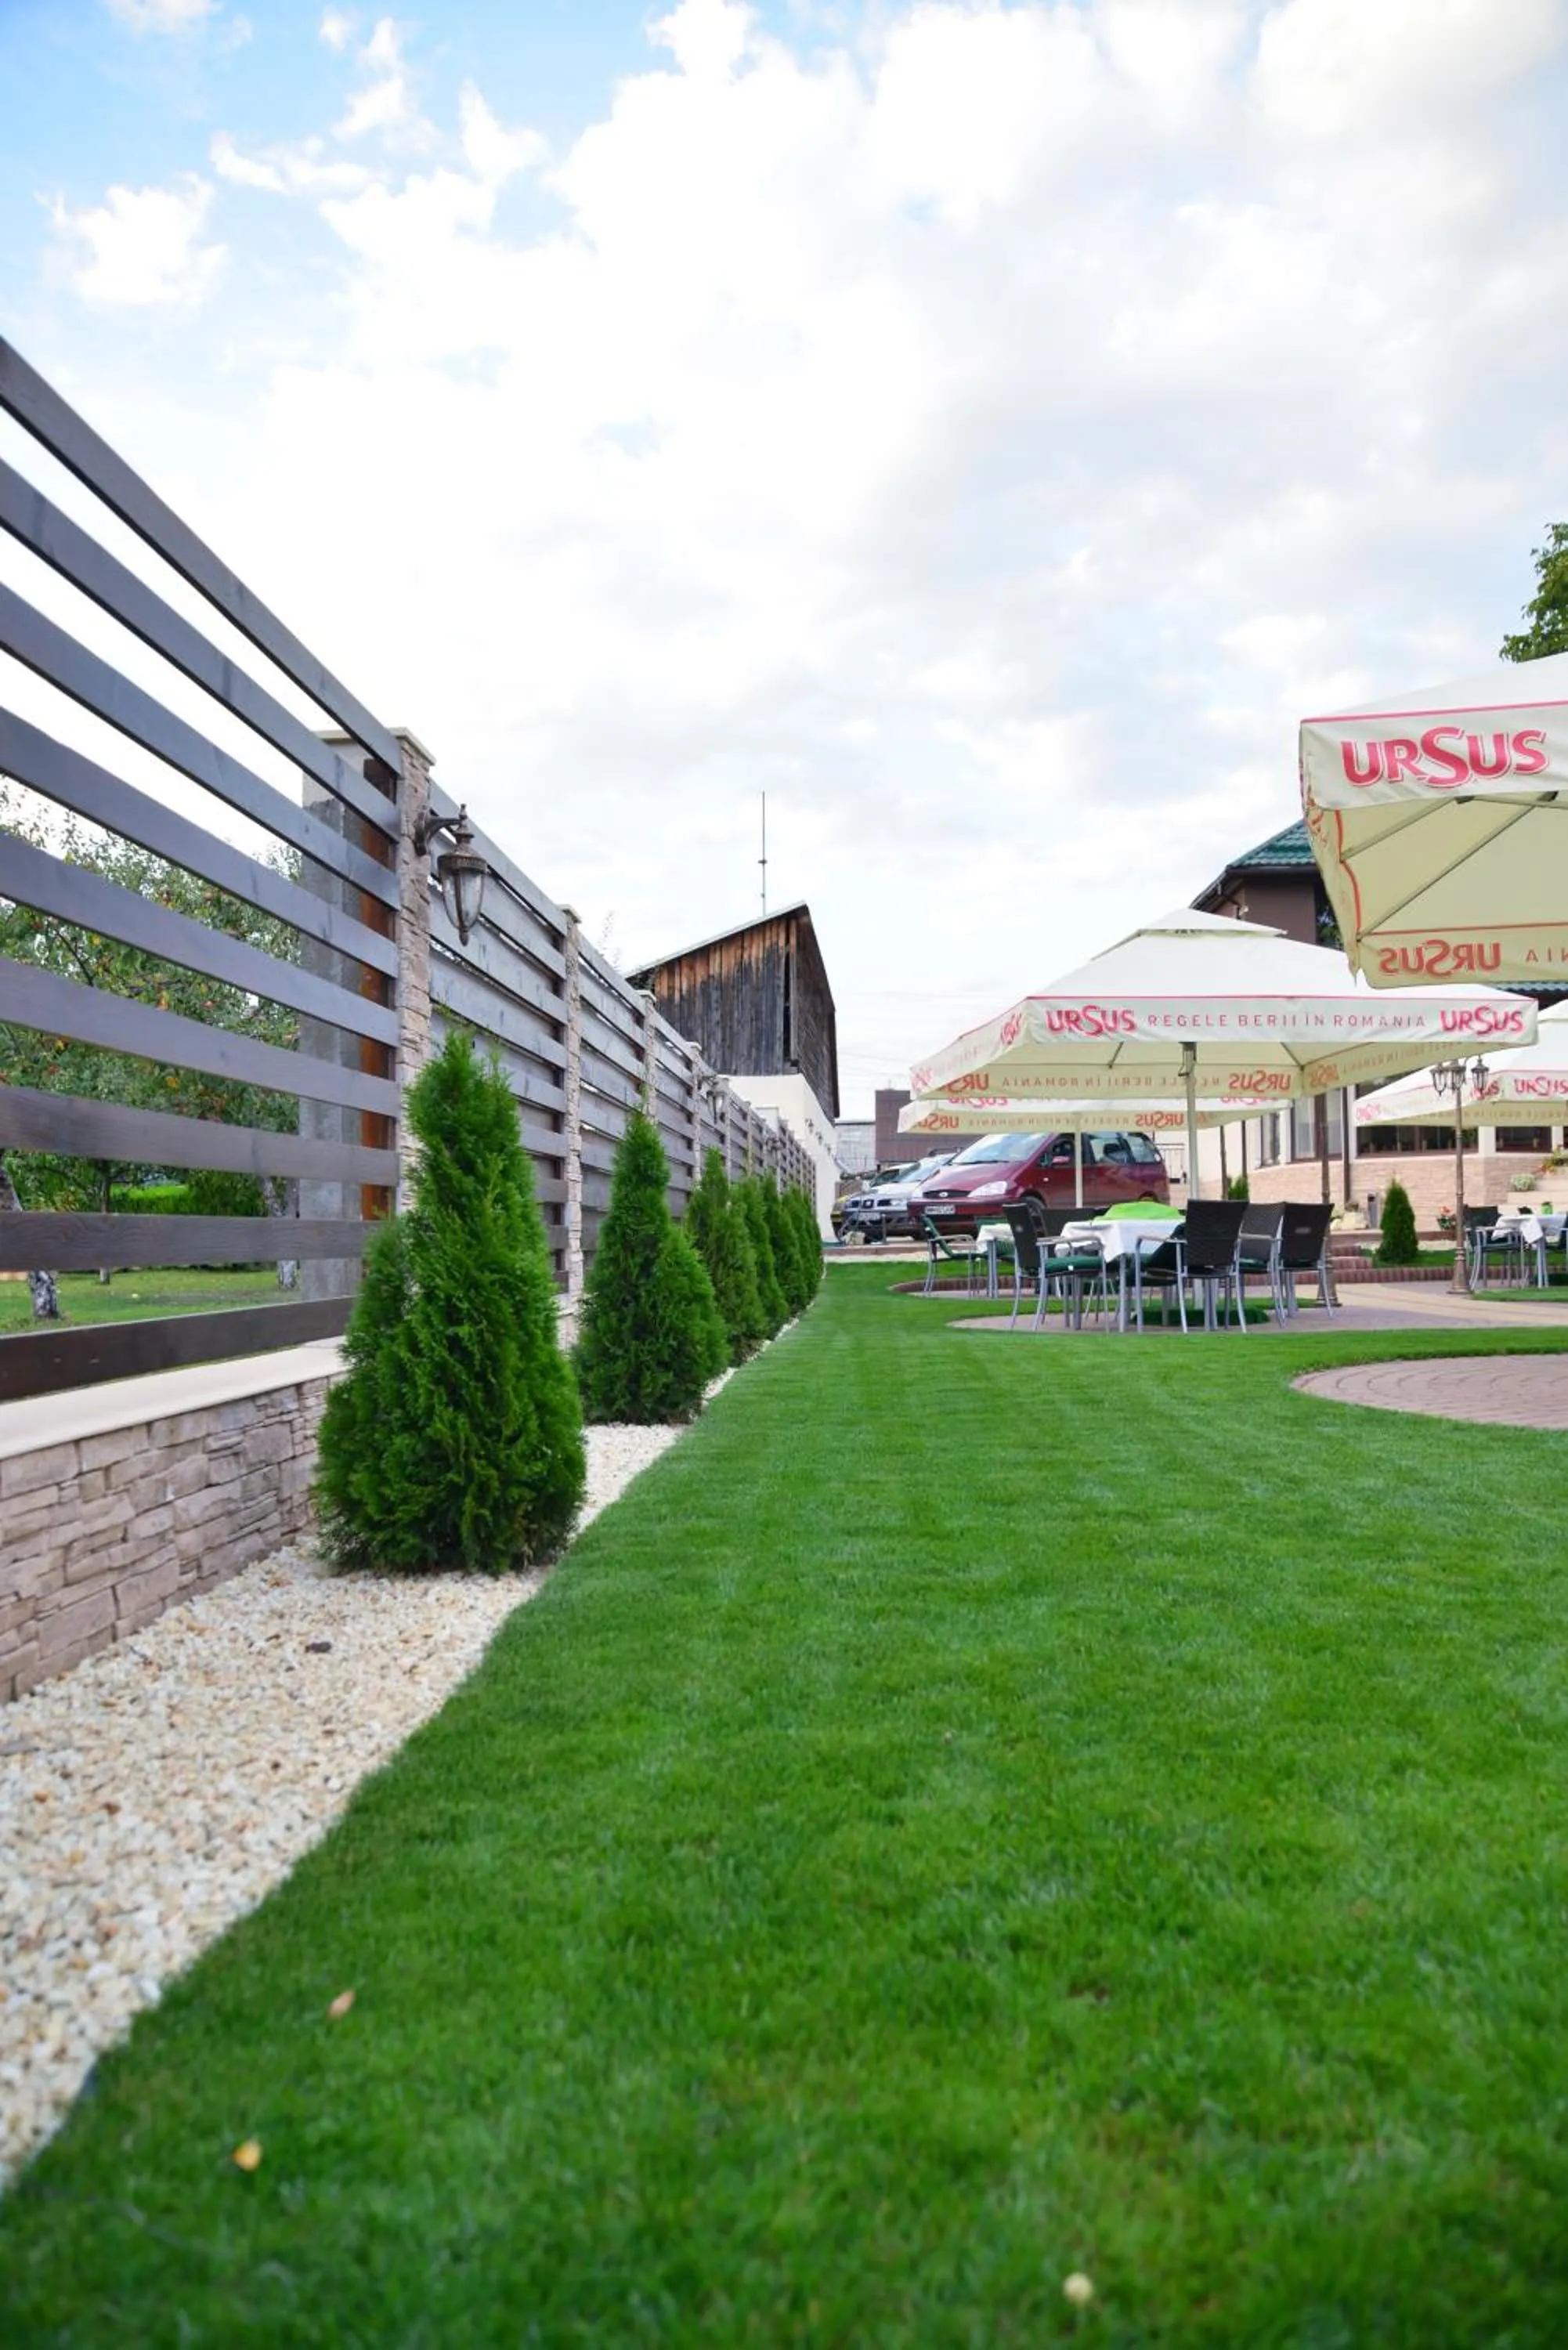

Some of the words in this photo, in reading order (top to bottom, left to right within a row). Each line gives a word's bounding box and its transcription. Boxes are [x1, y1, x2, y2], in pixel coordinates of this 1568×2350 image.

[1340, 725, 1549, 789] URSUS
[1046, 1004, 1138, 1037] URSUS
[1147, 1014, 1228, 1027] REGELE
[1238, 1014, 1296, 1027] BERII
[1439, 1006, 1524, 1036] URSUS
